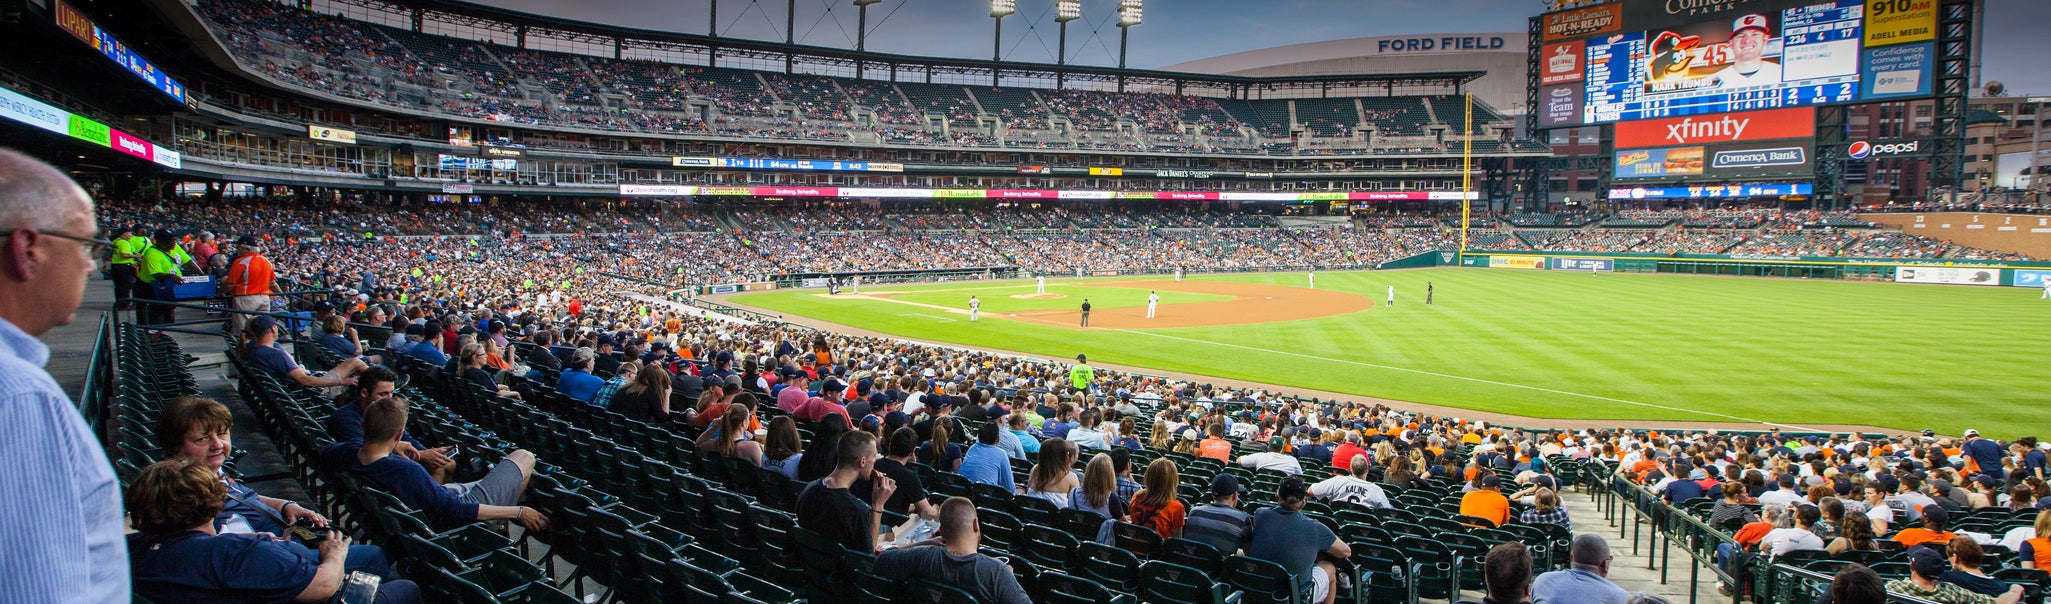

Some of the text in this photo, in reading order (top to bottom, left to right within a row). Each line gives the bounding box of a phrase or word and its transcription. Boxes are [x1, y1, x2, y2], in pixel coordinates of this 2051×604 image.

[1690, 2, 1734, 16] PARK
[1805, 3, 1837, 14] TRUMBO
[61, 4, 90, 41] LIPARI
[1562, 10, 1610, 24] Little Caesars
[1872, 11, 1930, 24] Superstation
[1549, 16, 1613, 34] HOT-N-READY
[1841, 28, 1854, 38] 17
[1871, 27, 1928, 41] ADELL MEDIA
[1378, 36, 1504, 53] FORD FIELD
[1786, 34, 1806, 45] .236
[1703, 43, 1727, 66] 45
[1872, 46, 1925, 57] Confidence
[1871, 53, 1924, 64] comes with
[1871, 60, 1921, 72] every card.
[1652, 81, 1676, 92] MARK
[1678, 78, 1713, 90] TRUMBO
[1840, 83, 1851, 94] 2
[1788, 88, 1798, 99] 2
[1814, 86, 1823, 97] 1
[1549, 102, 1574, 112] Team
[1666, 115, 1750, 143] xfinity
[1872, 140, 1918, 156] pepsi
[1769, 151, 1797, 161] Bank
[1157, 169, 1188, 178] JACK DANIEL'S
[1561, 258, 1577, 269] Lite
[1234, 431, 1248, 440] 24
[1345, 485, 1368, 498] KALINE
